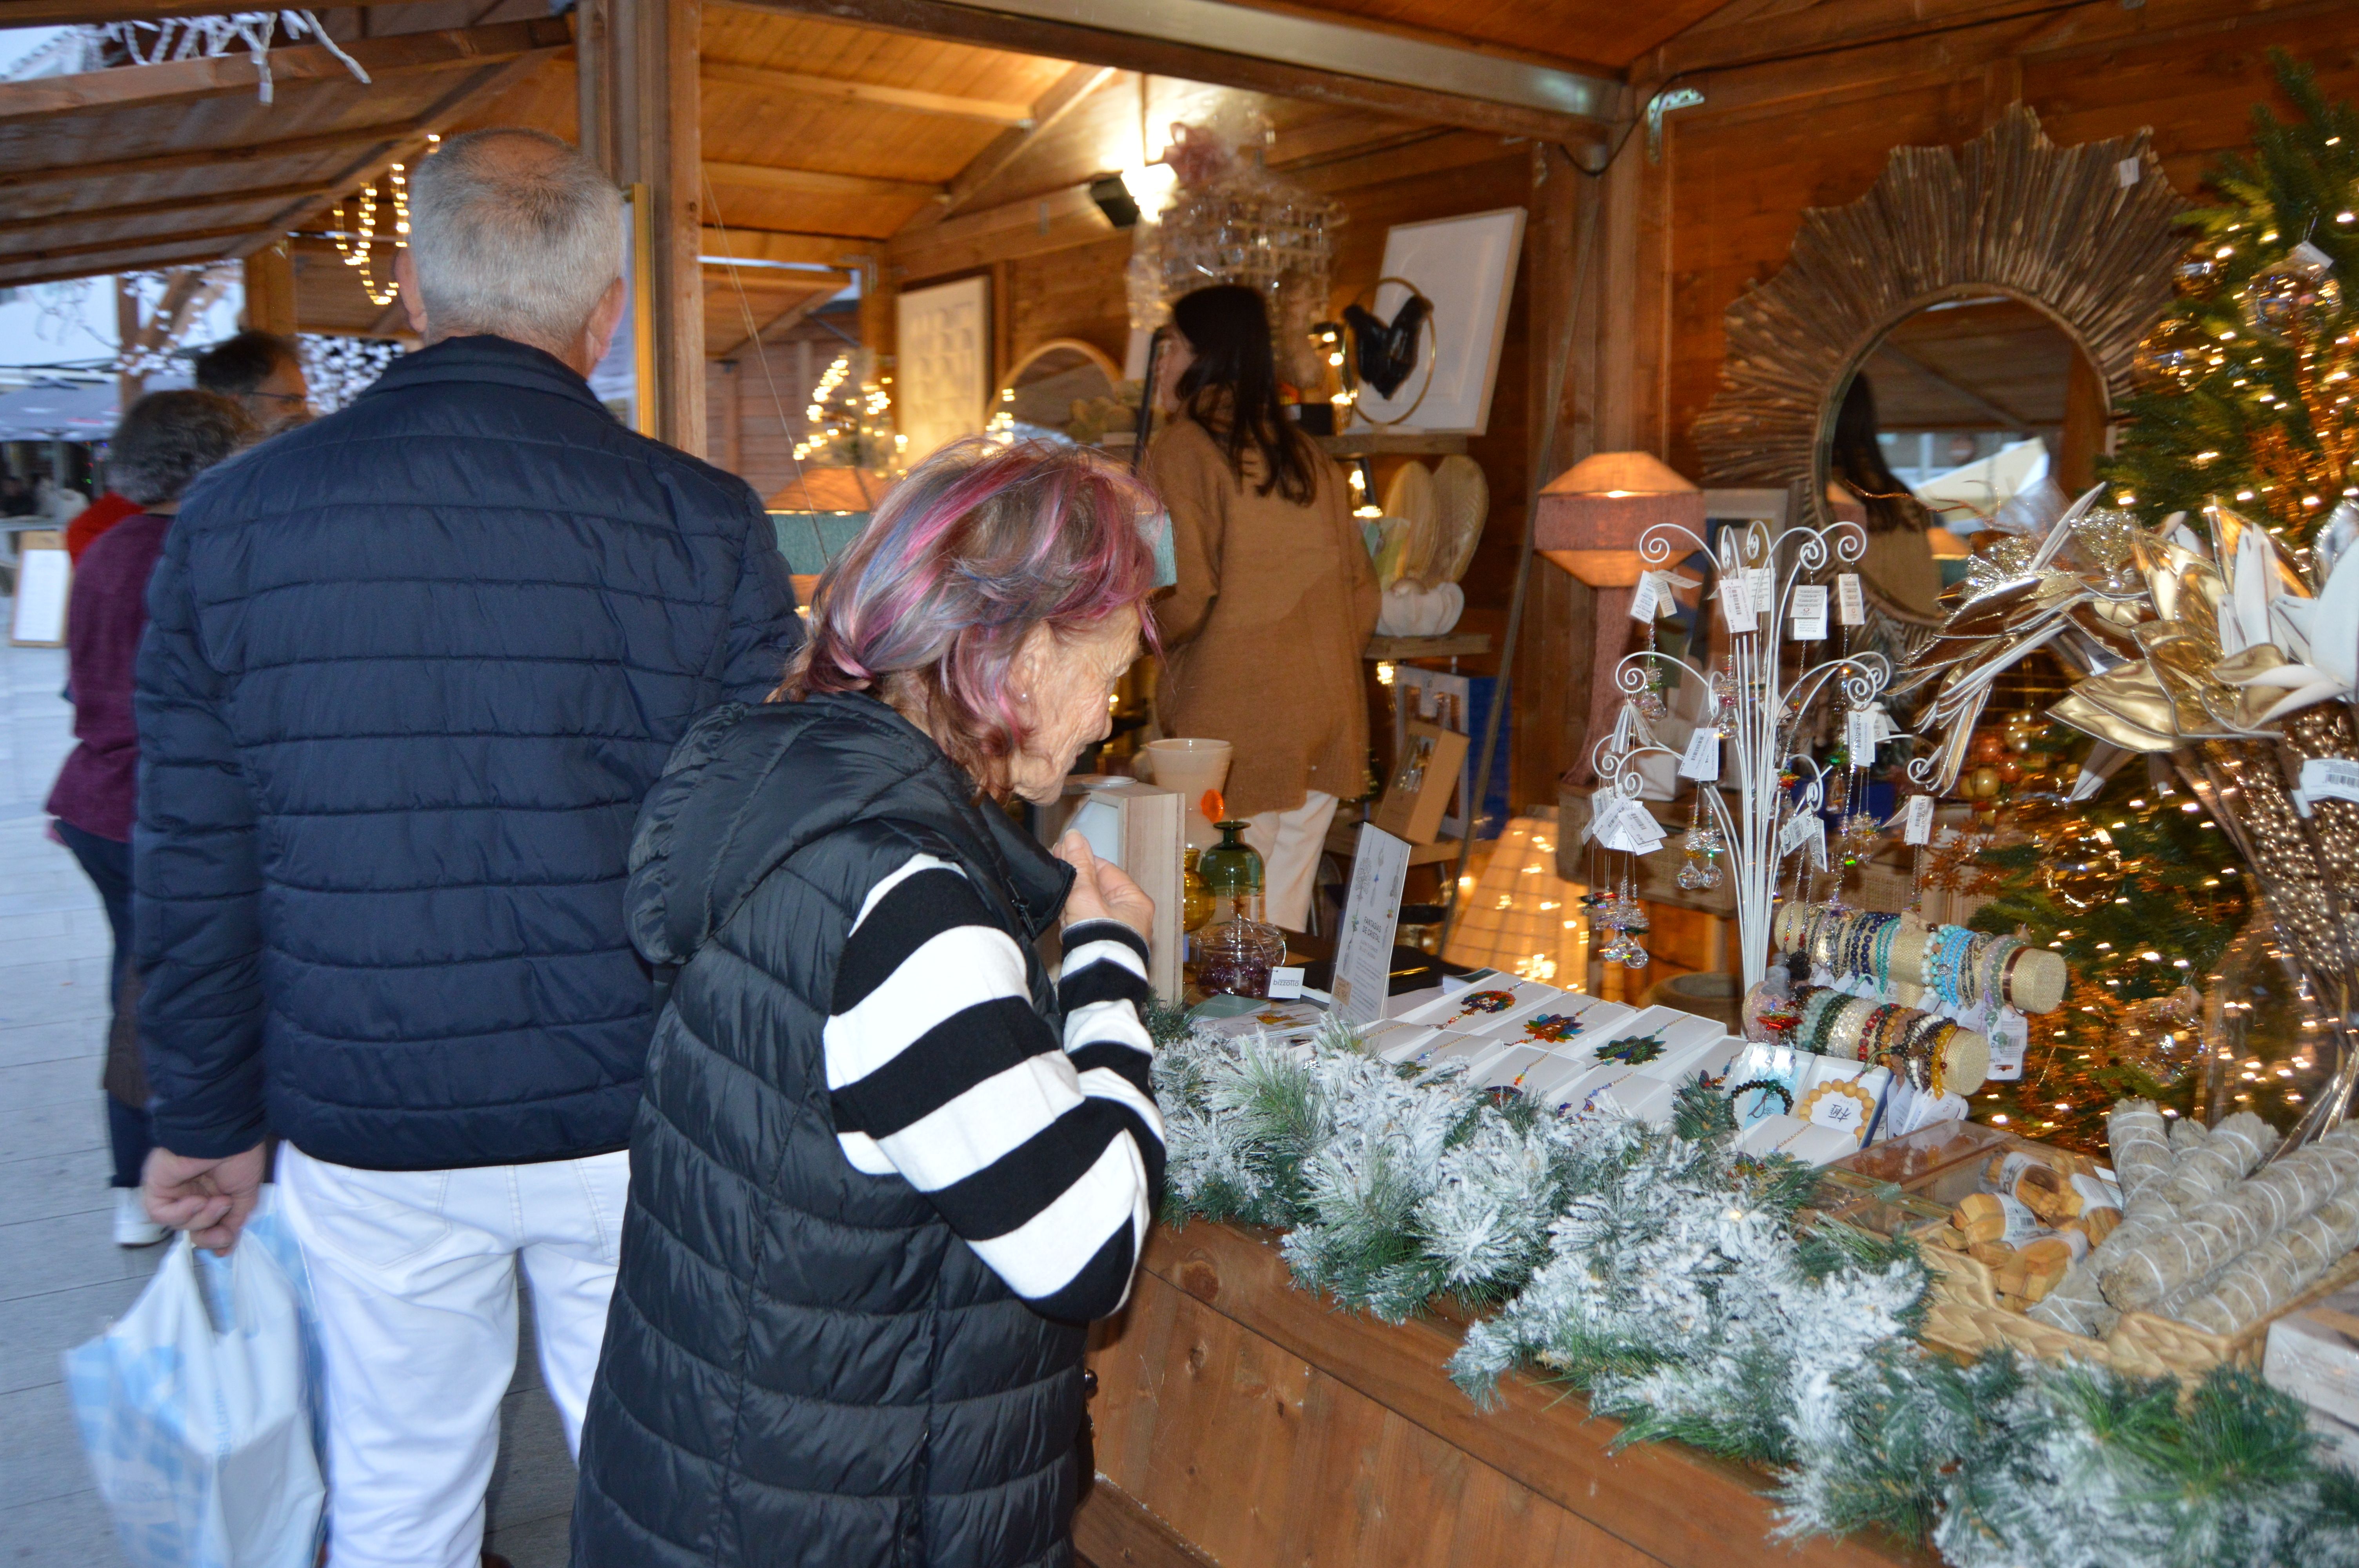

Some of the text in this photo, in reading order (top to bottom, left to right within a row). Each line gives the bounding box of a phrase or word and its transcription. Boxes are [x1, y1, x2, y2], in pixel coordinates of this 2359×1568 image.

[1363, 916, 1381, 933] FANTASÍAS
[1362, 926, 1380, 943] DE CRISTAL
[1273, 978, 1299, 987] bizzotto
